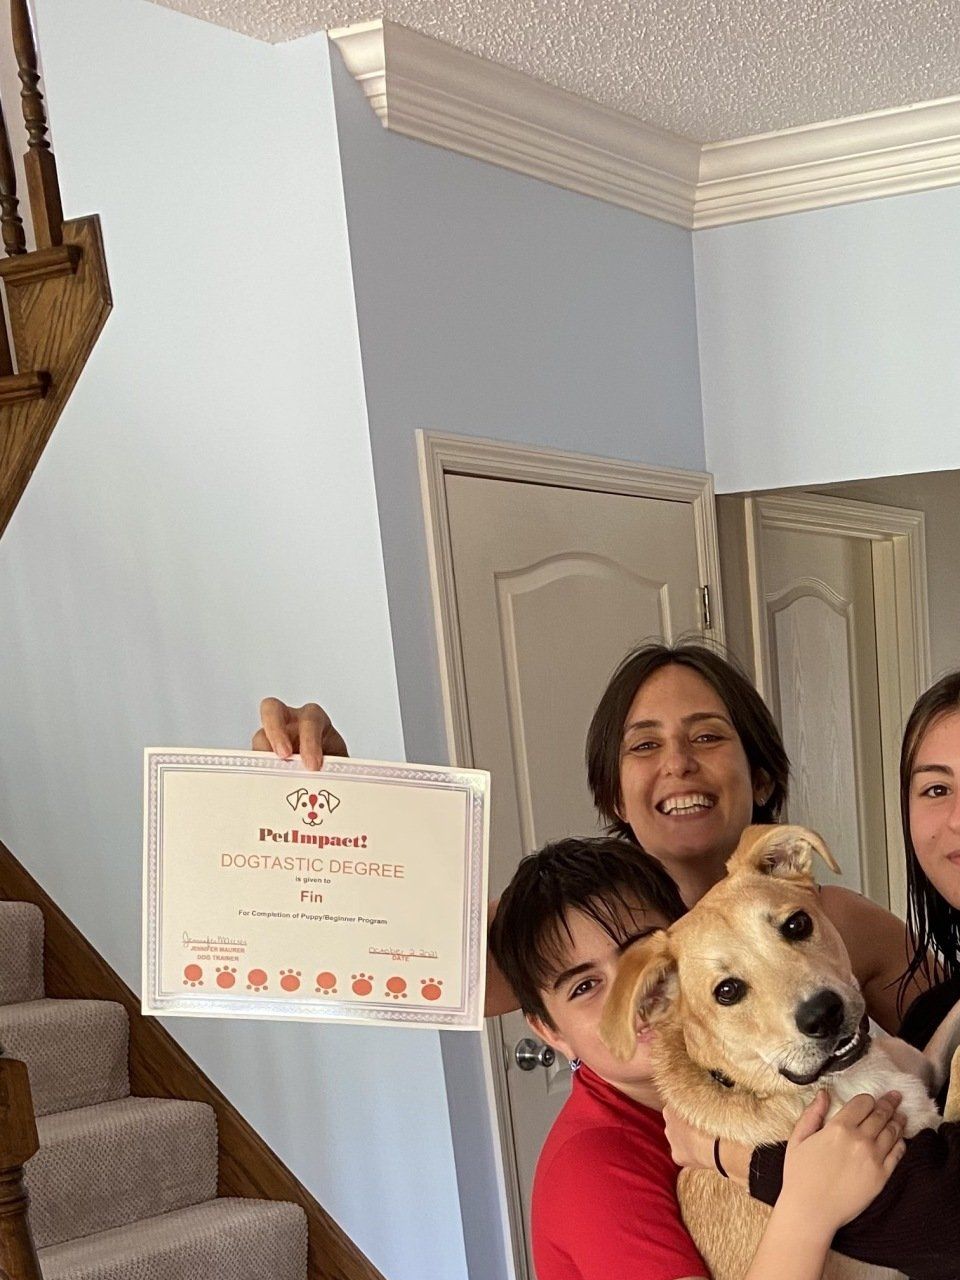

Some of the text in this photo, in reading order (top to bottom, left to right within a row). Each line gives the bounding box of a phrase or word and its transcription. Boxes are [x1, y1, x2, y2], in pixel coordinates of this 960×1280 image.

[221, 853, 405, 879] DOGTASTIC DEGREE
[303, 877, 322, 885] given
[300, 890, 323, 903] Fin
[251, 910, 291, 920] Completion
[300, 913, 356, 924] Puppy/Beginner
[357, 916, 388, 927] Program
